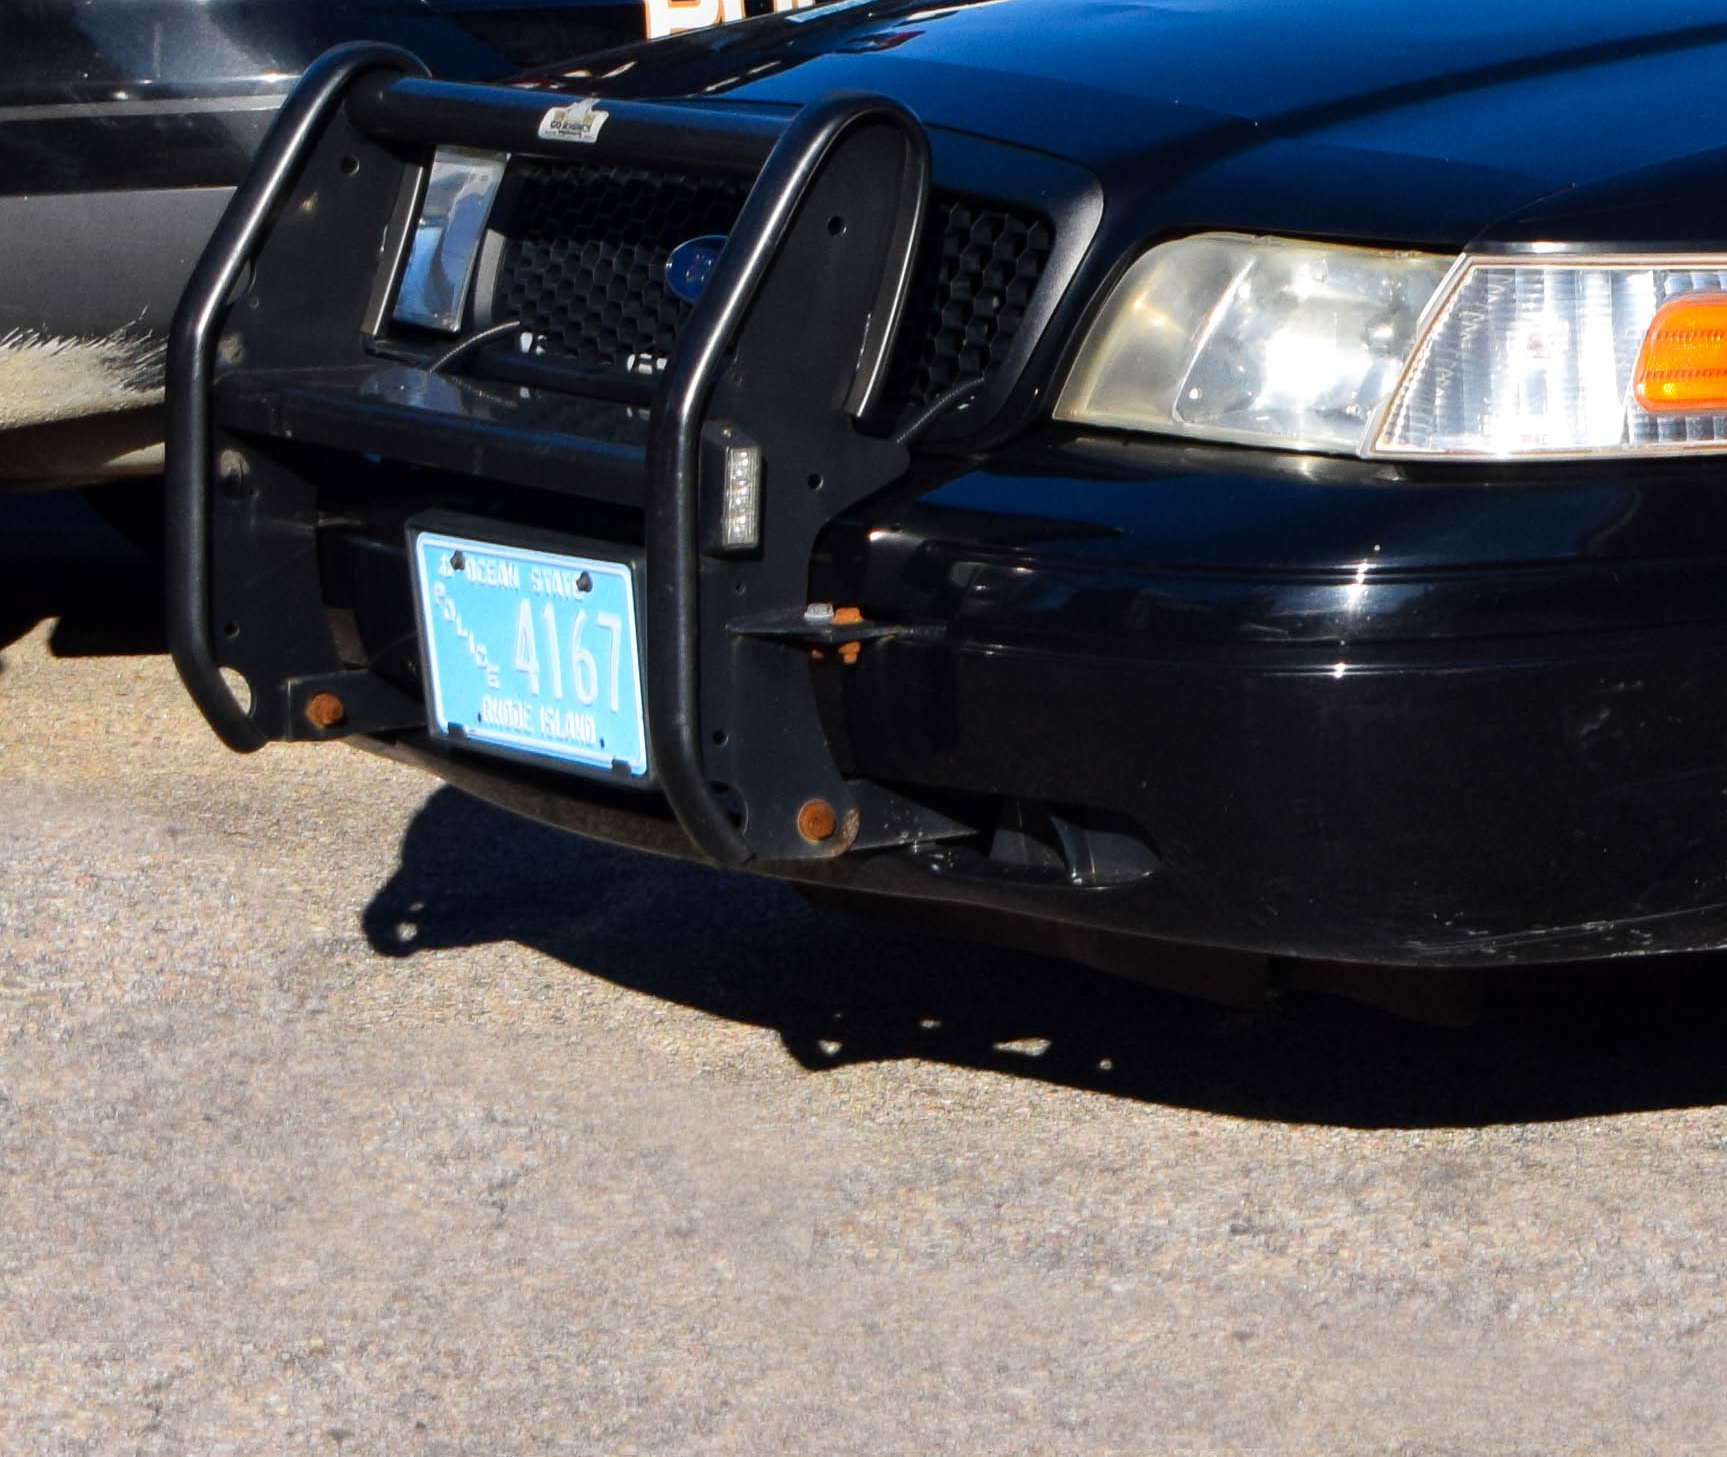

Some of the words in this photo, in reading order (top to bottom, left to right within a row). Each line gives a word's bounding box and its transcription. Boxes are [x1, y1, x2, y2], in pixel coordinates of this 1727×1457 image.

[465, 557, 520, 591] OCEAN
[433, 581, 500, 690] POLICE
[514, 597, 622, 712] 4167
[481, 694, 534, 733] RHODE
[540, 706, 597, 743] ISLAND
